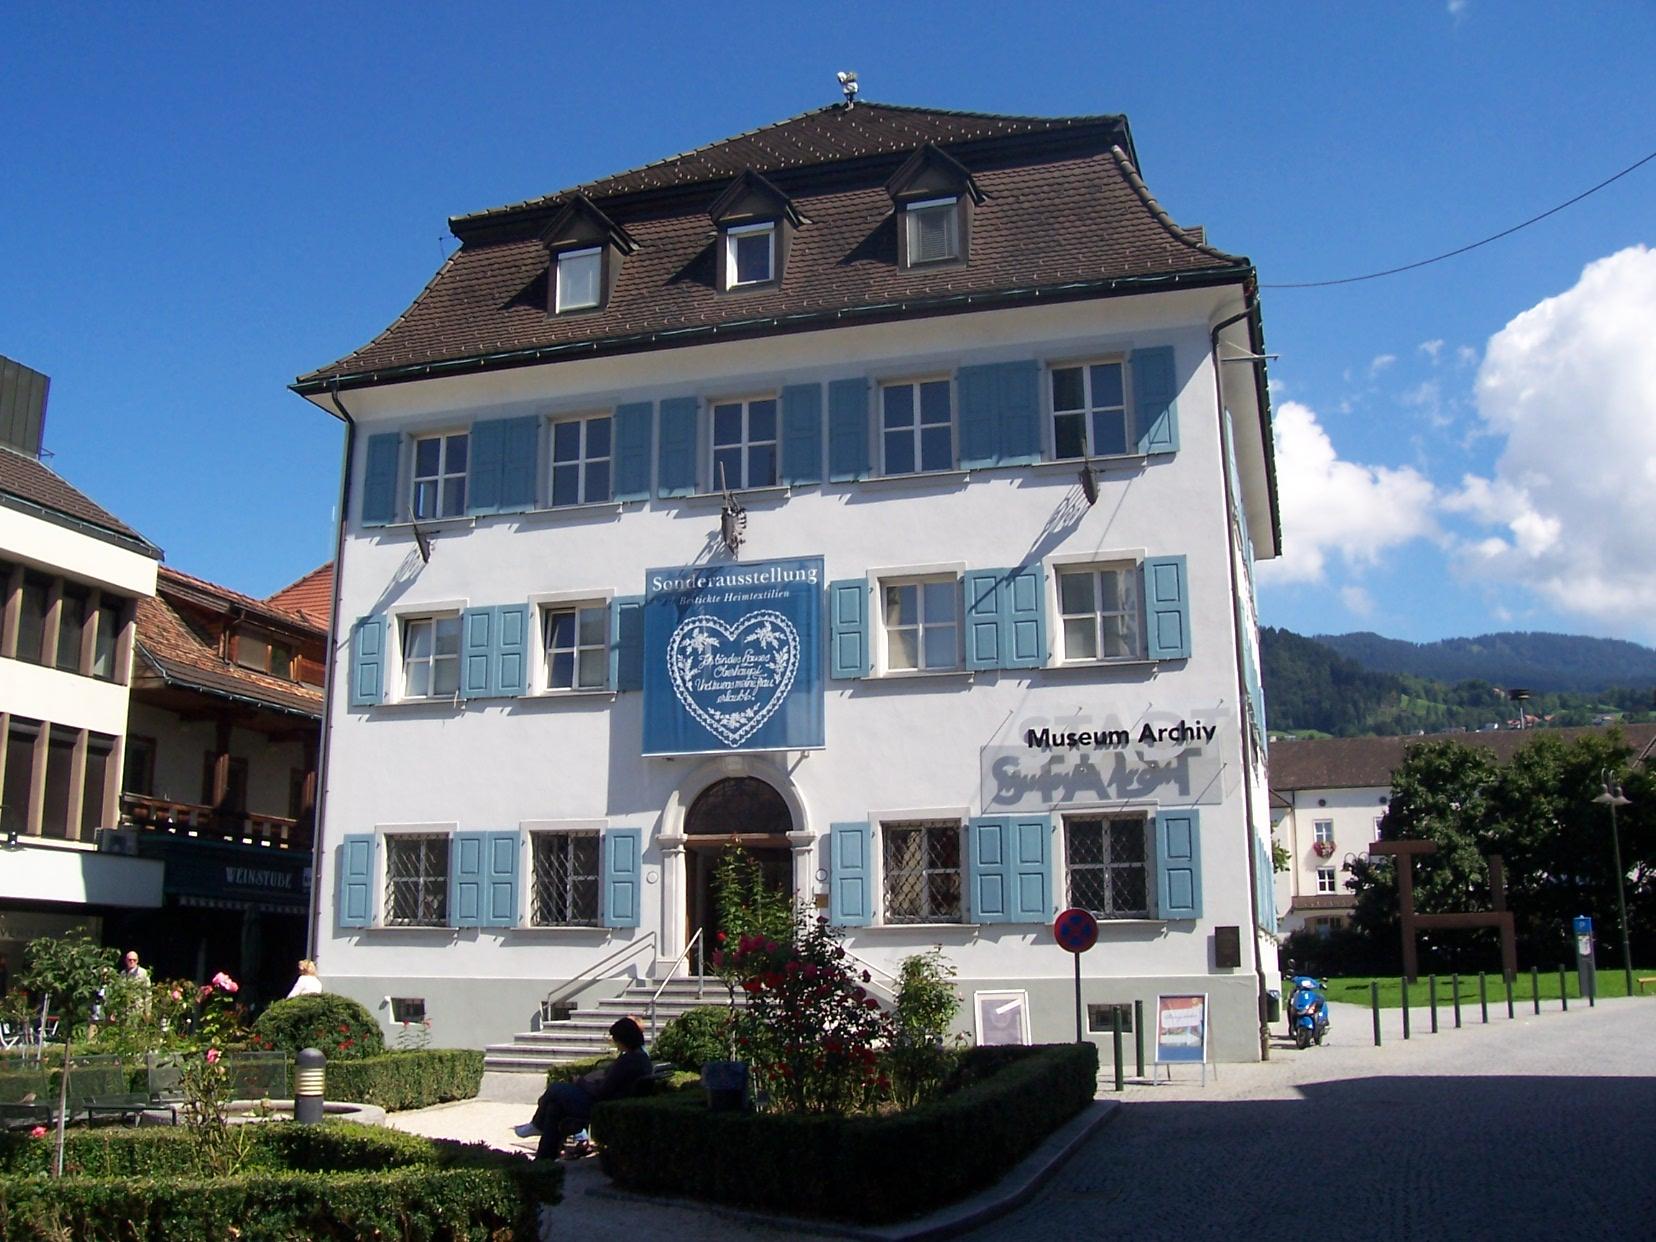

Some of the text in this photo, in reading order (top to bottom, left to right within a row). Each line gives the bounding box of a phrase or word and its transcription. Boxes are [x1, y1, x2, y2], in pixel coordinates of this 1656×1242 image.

[652, 567, 818, 592] Sonderausstellung
[723, 588, 790, 602] Heimtextilien
[1027, 720, 1217, 748] Museum Archiv
[226, 866, 292, 889] WEINSTUBE
